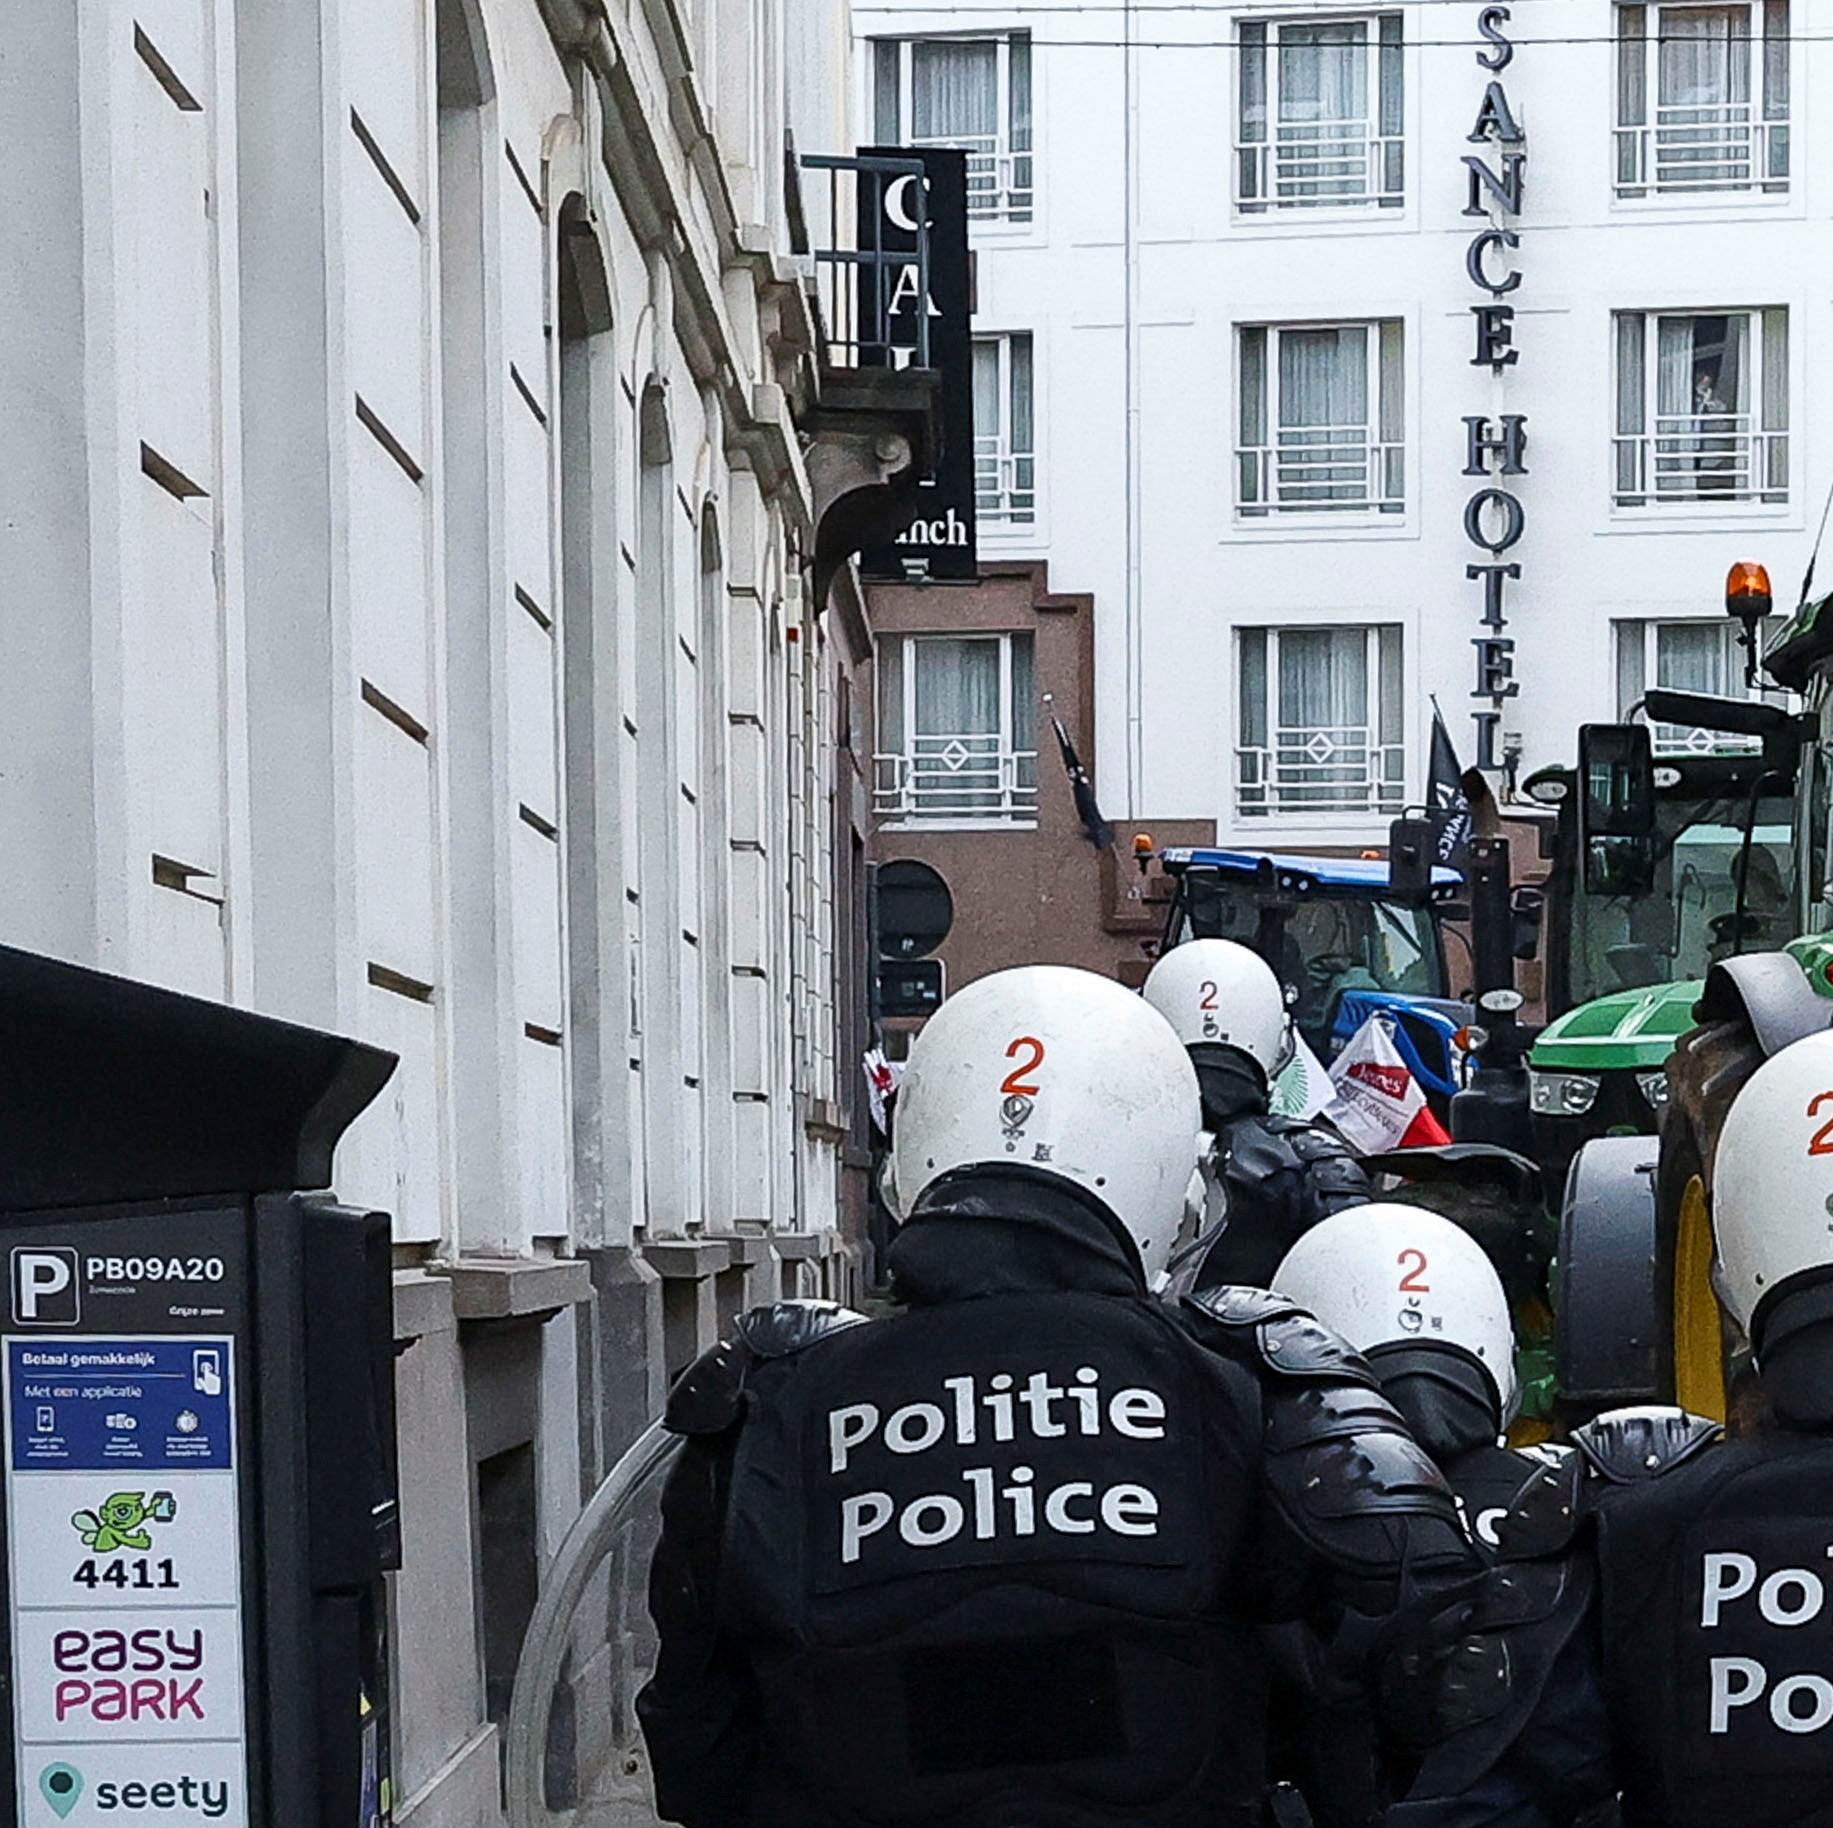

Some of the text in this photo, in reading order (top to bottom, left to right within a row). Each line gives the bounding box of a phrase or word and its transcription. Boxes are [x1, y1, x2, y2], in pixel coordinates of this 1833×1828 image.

[894, 509, 968, 546] nch
[1460, 414, 1529, 771] HOTEL
[1199, 981, 1219, 1010] 2
[1001, 1036, 1045, 1096] 2
[20, 1254, 70, 1317] P
[87, 1258, 224, 1281] PB09A20
[1397, 1248, 1430, 1292] 2
[70, 1352, 155, 1367] gemakkelijk
[829, 1366, 1167, 1474] Politie
[842, 1466, 1159, 1563] Police
[73, 1559, 180, 1589] 4411
[54, 1629, 204, 1674] easy
[96, 1776, 230, 1816] seety
